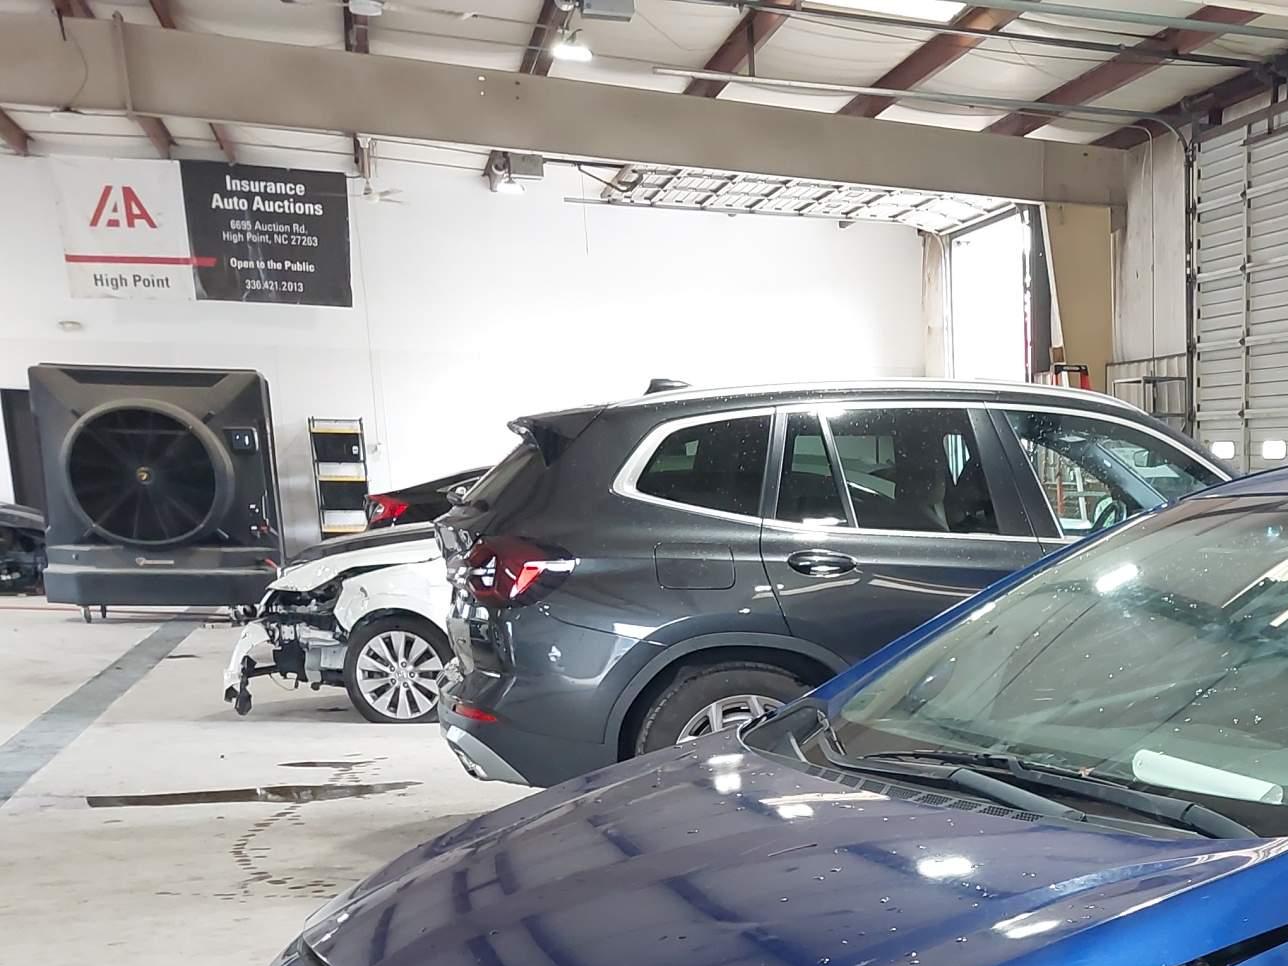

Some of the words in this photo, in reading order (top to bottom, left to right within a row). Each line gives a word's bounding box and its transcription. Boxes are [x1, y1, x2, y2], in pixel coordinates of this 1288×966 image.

[225, 174, 305, 195] Insurance
[211, 193, 249, 211] Auto
[252, 196, 324, 216] Auctions
[254, 221, 291, 233] Auction
[293, 223, 308, 234] Rd.
[222, 231, 244, 243] High
[246, 232, 272, 244] Point,
[274, 235, 288, 245] NC
[230, 257, 254, 270] Open
[256, 259, 265, 269] to
[267, 260, 282, 270] the
[285, 261, 315, 272] Public
[93, 273, 128, 291] High
[132, 274, 171, 289] Point
